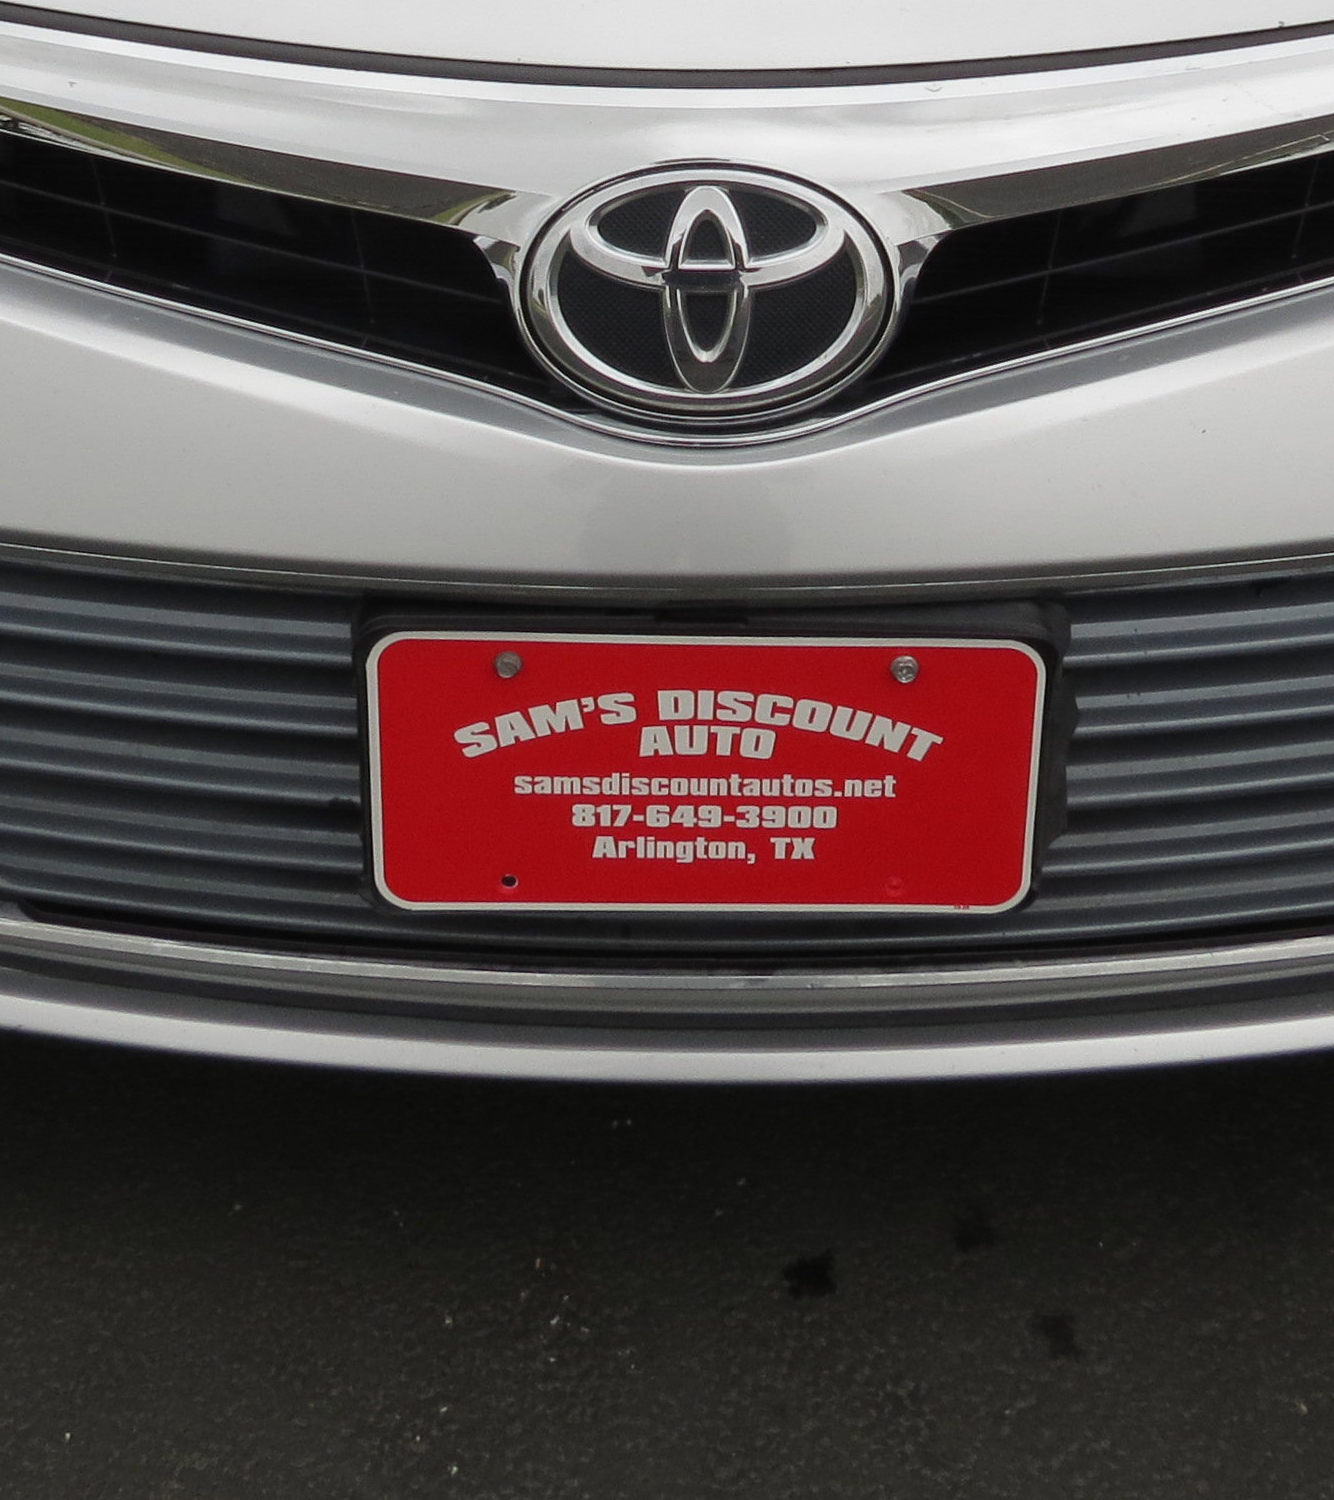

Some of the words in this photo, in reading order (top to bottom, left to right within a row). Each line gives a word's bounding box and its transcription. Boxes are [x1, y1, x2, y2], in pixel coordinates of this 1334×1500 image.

[454, 692, 637, 758] SAM'S
[657, 689, 944, 762] DISCOUNT
[639, 725, 777, 760] AUTO
[514, 772, 897, 798] samsdiscountautos.net
[571, 803, 838, 829] 817-649-3900
[592, 835, 756, 865] Arlington,
[769, 837, 816, 860] TX
